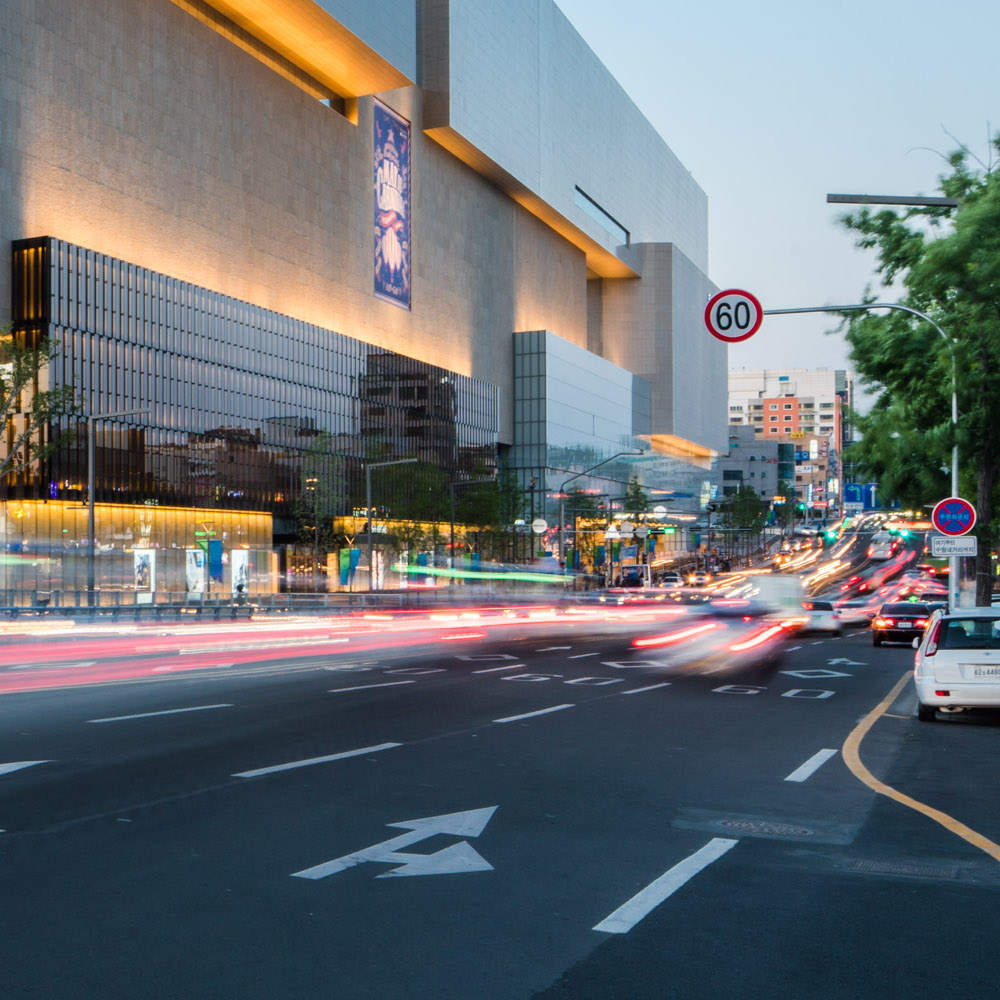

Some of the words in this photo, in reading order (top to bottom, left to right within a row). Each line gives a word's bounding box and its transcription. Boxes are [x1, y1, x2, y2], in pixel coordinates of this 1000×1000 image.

[716, 301, 751, 331] 60
[501, 673, 625, 686] 60
[711, 684, 836, 699] 60
